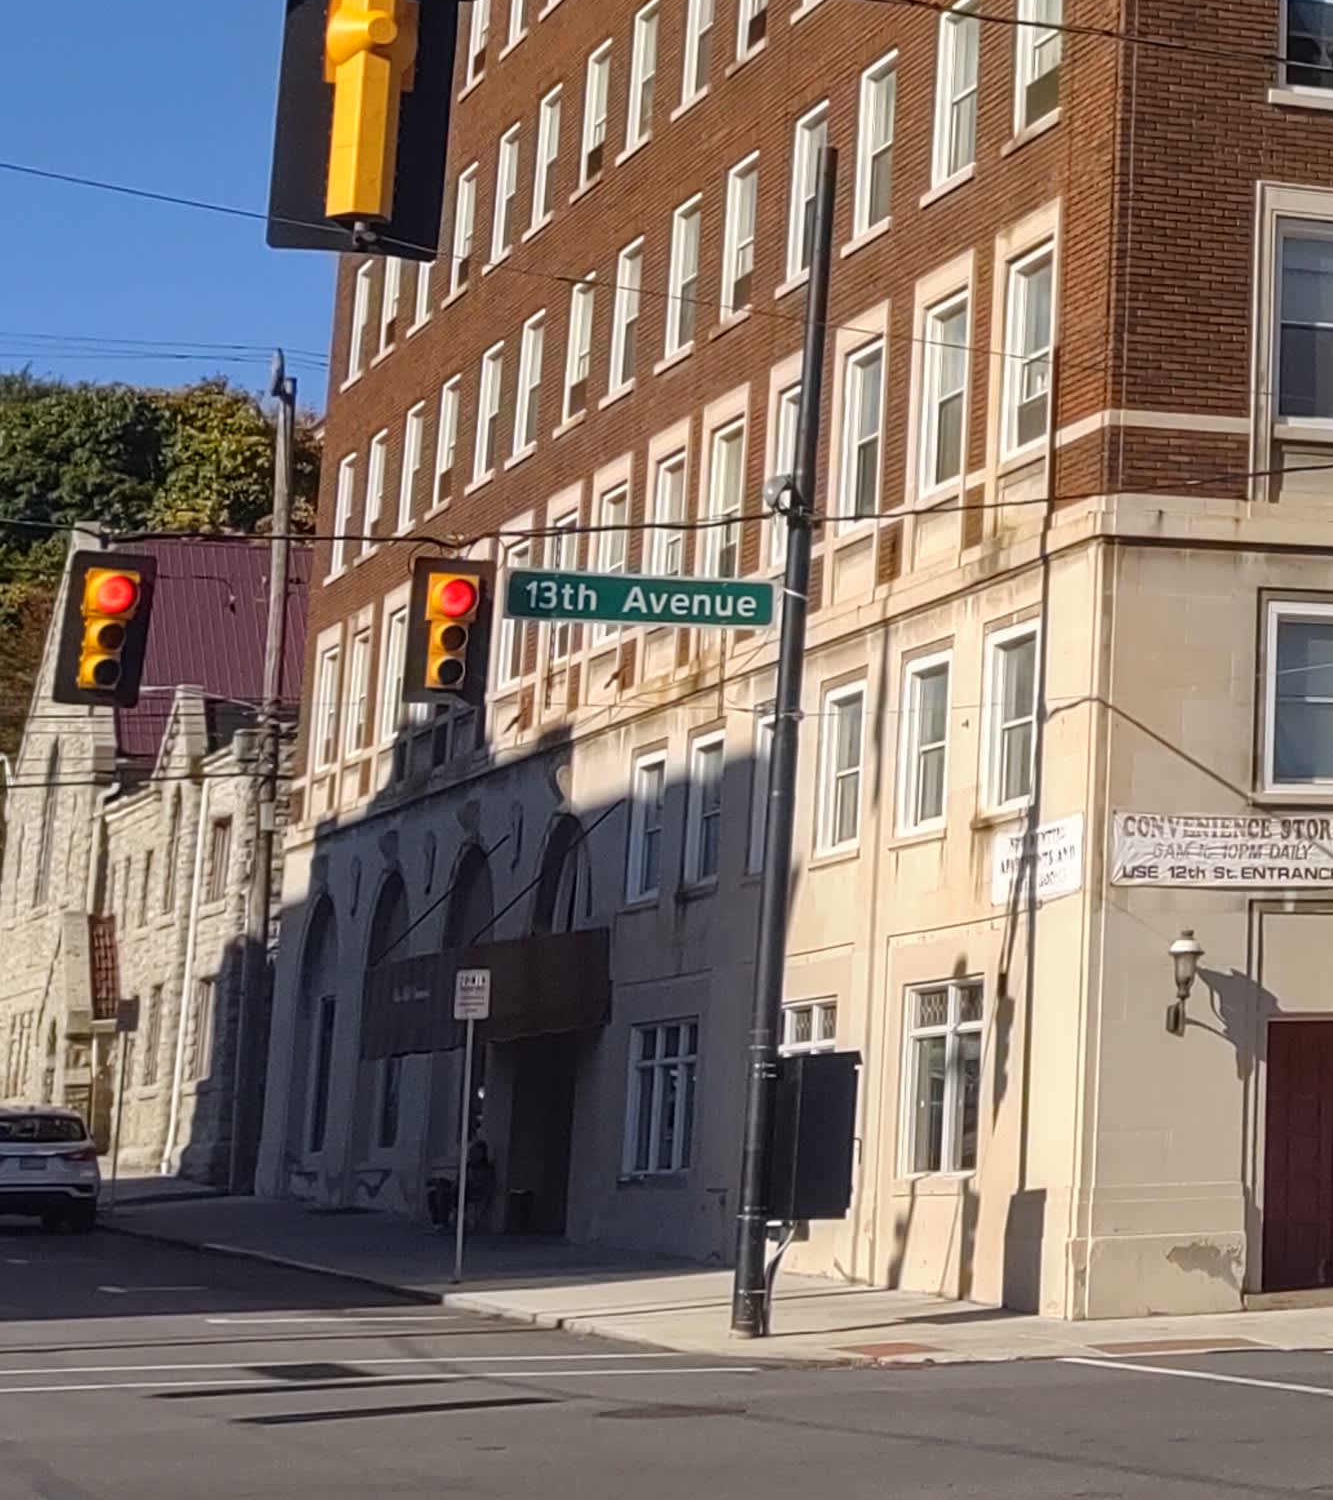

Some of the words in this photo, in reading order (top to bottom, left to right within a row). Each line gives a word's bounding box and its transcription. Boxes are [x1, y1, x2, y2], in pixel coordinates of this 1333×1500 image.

[524, 580, 598, 612] 13th
[621, 586, 758, 617] Avenue
[1122, 815, 1273, 839] CONVENIENCE
[1268, 843, 1313, 860] DAILY
[1121, 864, 1159, 879] USE
[1168, 865, 1206, 879] 12th
